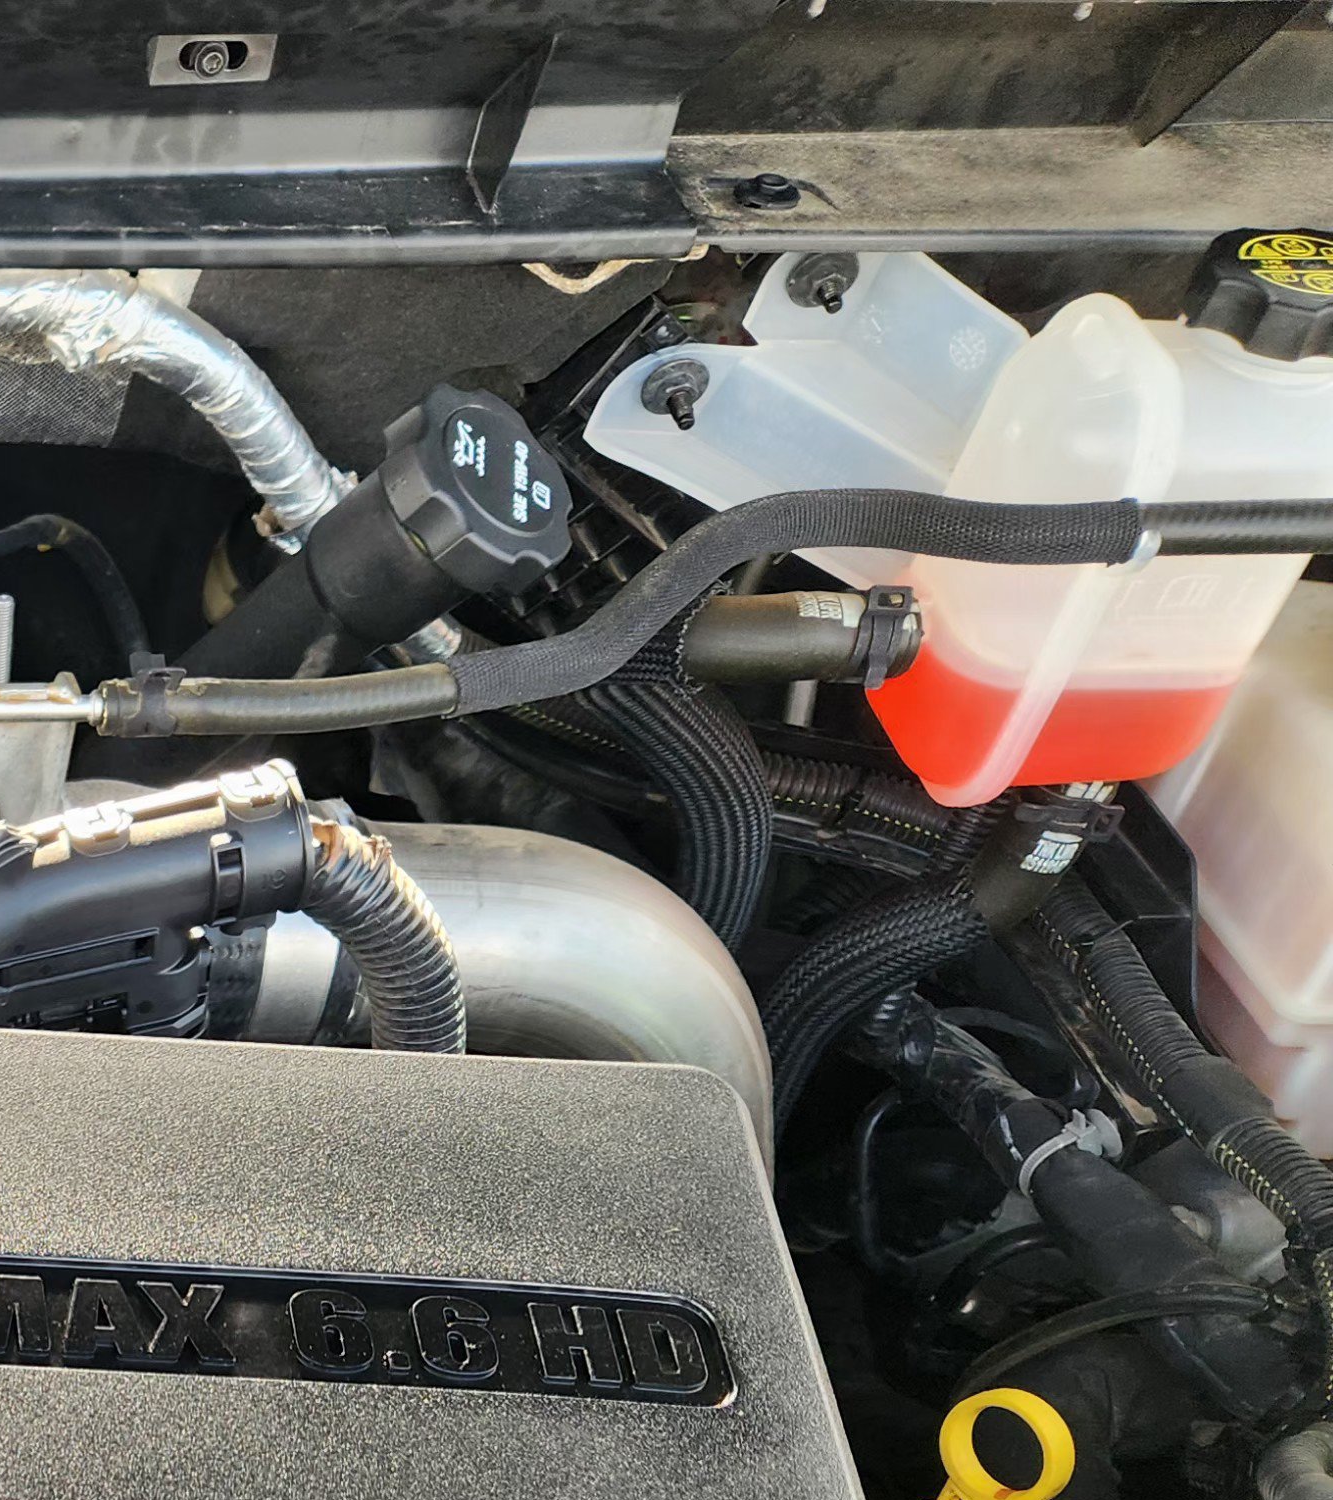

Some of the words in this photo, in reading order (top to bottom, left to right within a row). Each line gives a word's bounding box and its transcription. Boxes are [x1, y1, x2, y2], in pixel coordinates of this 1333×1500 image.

[513, 491, 528, 523] SAE
[289, 1287, 499, 1381] 6.6
[528, 1302, 707, 1394] HD
